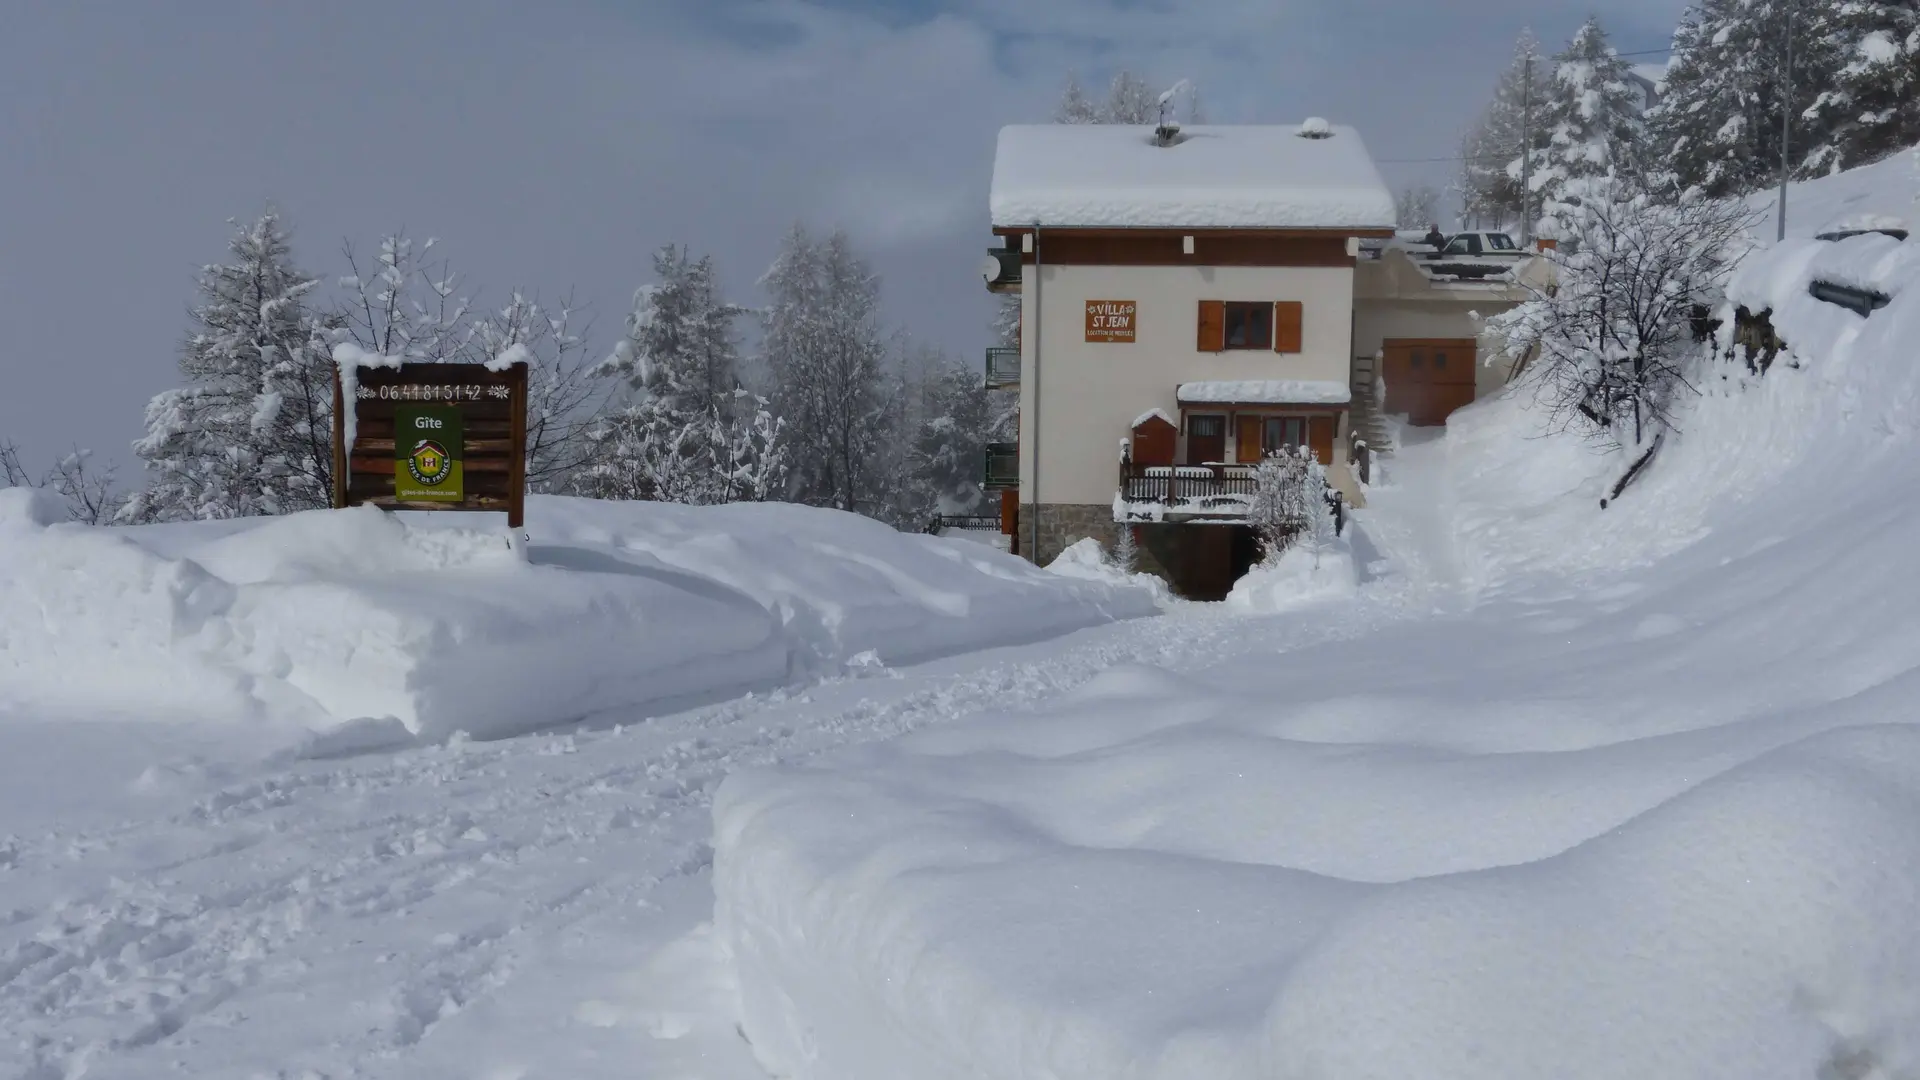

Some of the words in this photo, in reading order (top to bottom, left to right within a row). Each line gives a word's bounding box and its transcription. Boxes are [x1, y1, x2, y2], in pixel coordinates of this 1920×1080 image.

[1097, 304, 1125, 315] VILLA
[1092, 315, 1105, 328] ST
[1106, 315, 1129, 328] JEAN
[415, 416, 443, 429] Gîte
[432, 458, 449, 483] FRANCE
